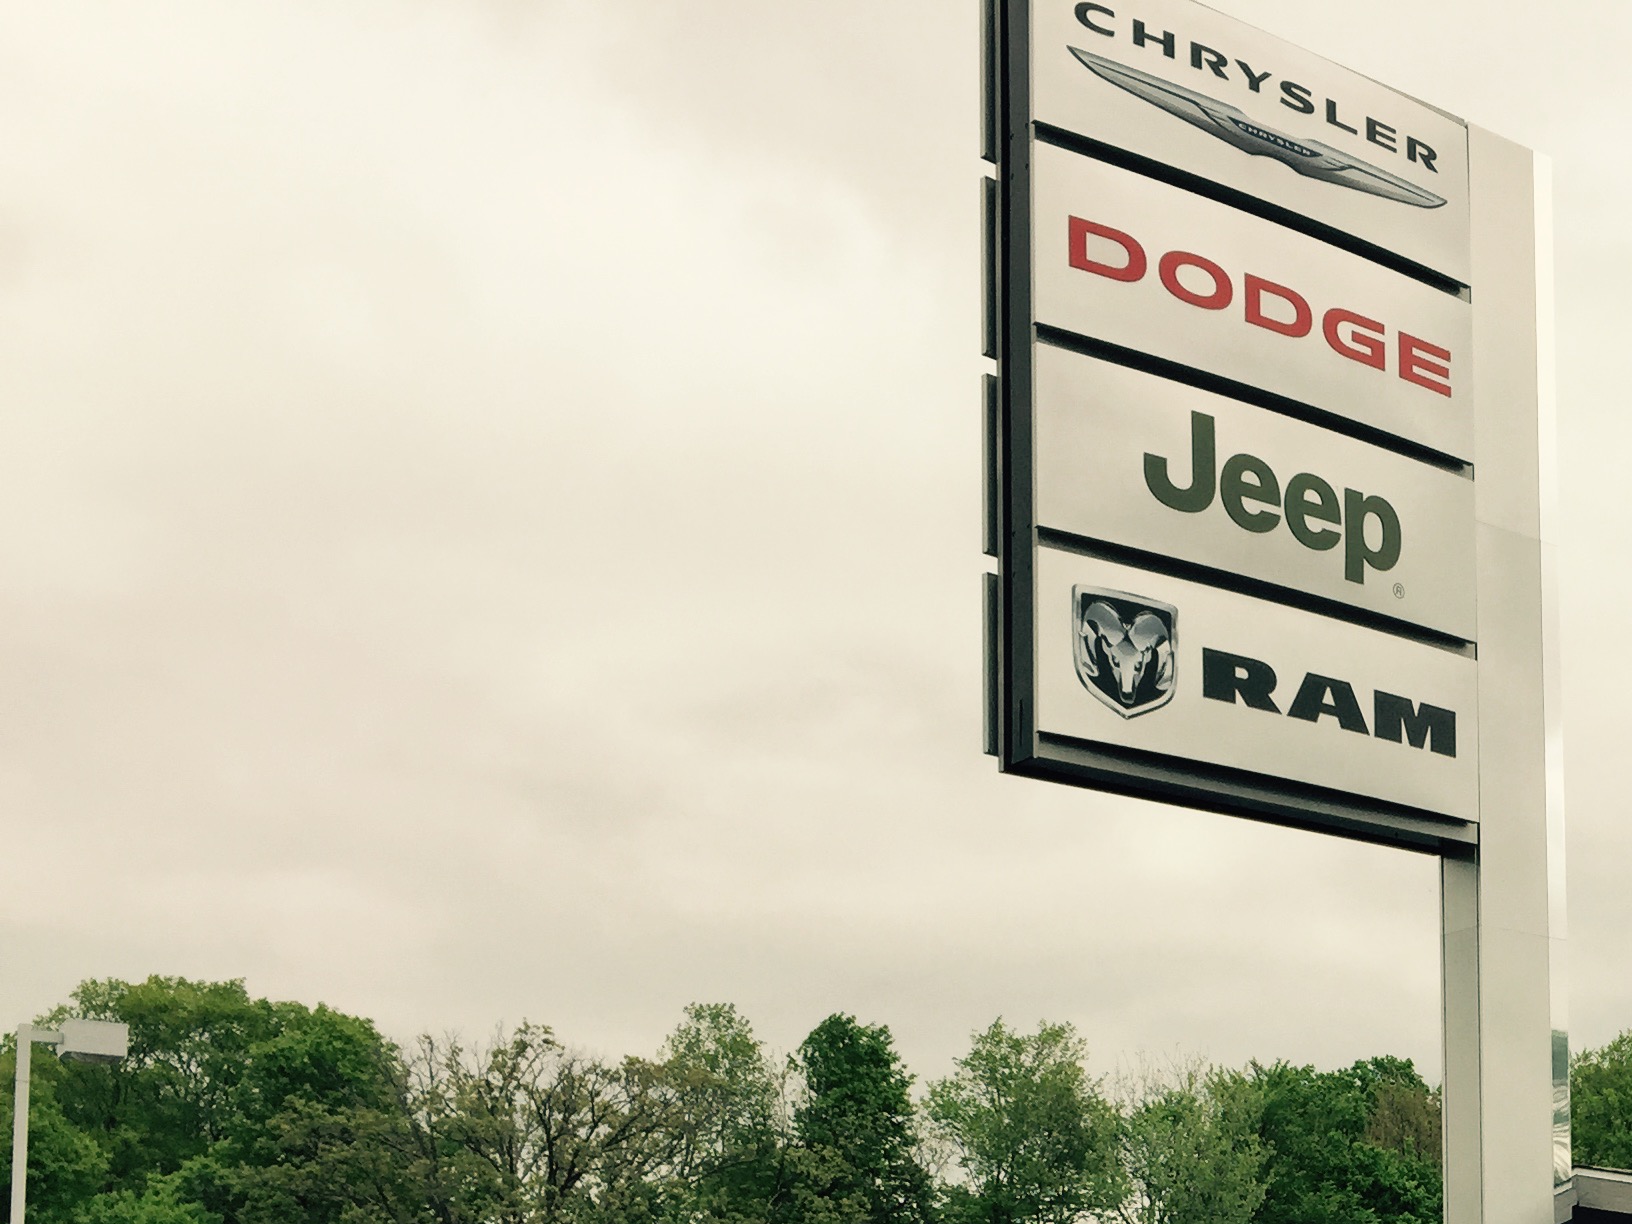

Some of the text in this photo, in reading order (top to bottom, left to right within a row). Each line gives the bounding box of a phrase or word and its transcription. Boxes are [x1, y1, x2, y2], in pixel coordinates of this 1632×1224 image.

[1074, 1, 1439, 174] CHRYSLER
[1238, 122, 1312, 156] CHRYSLER
[1068, 214, 1452, 399] DODGE
[1143, 410, 1402, 585] Jeep
[1202, 646, 1457, 759] RAM
